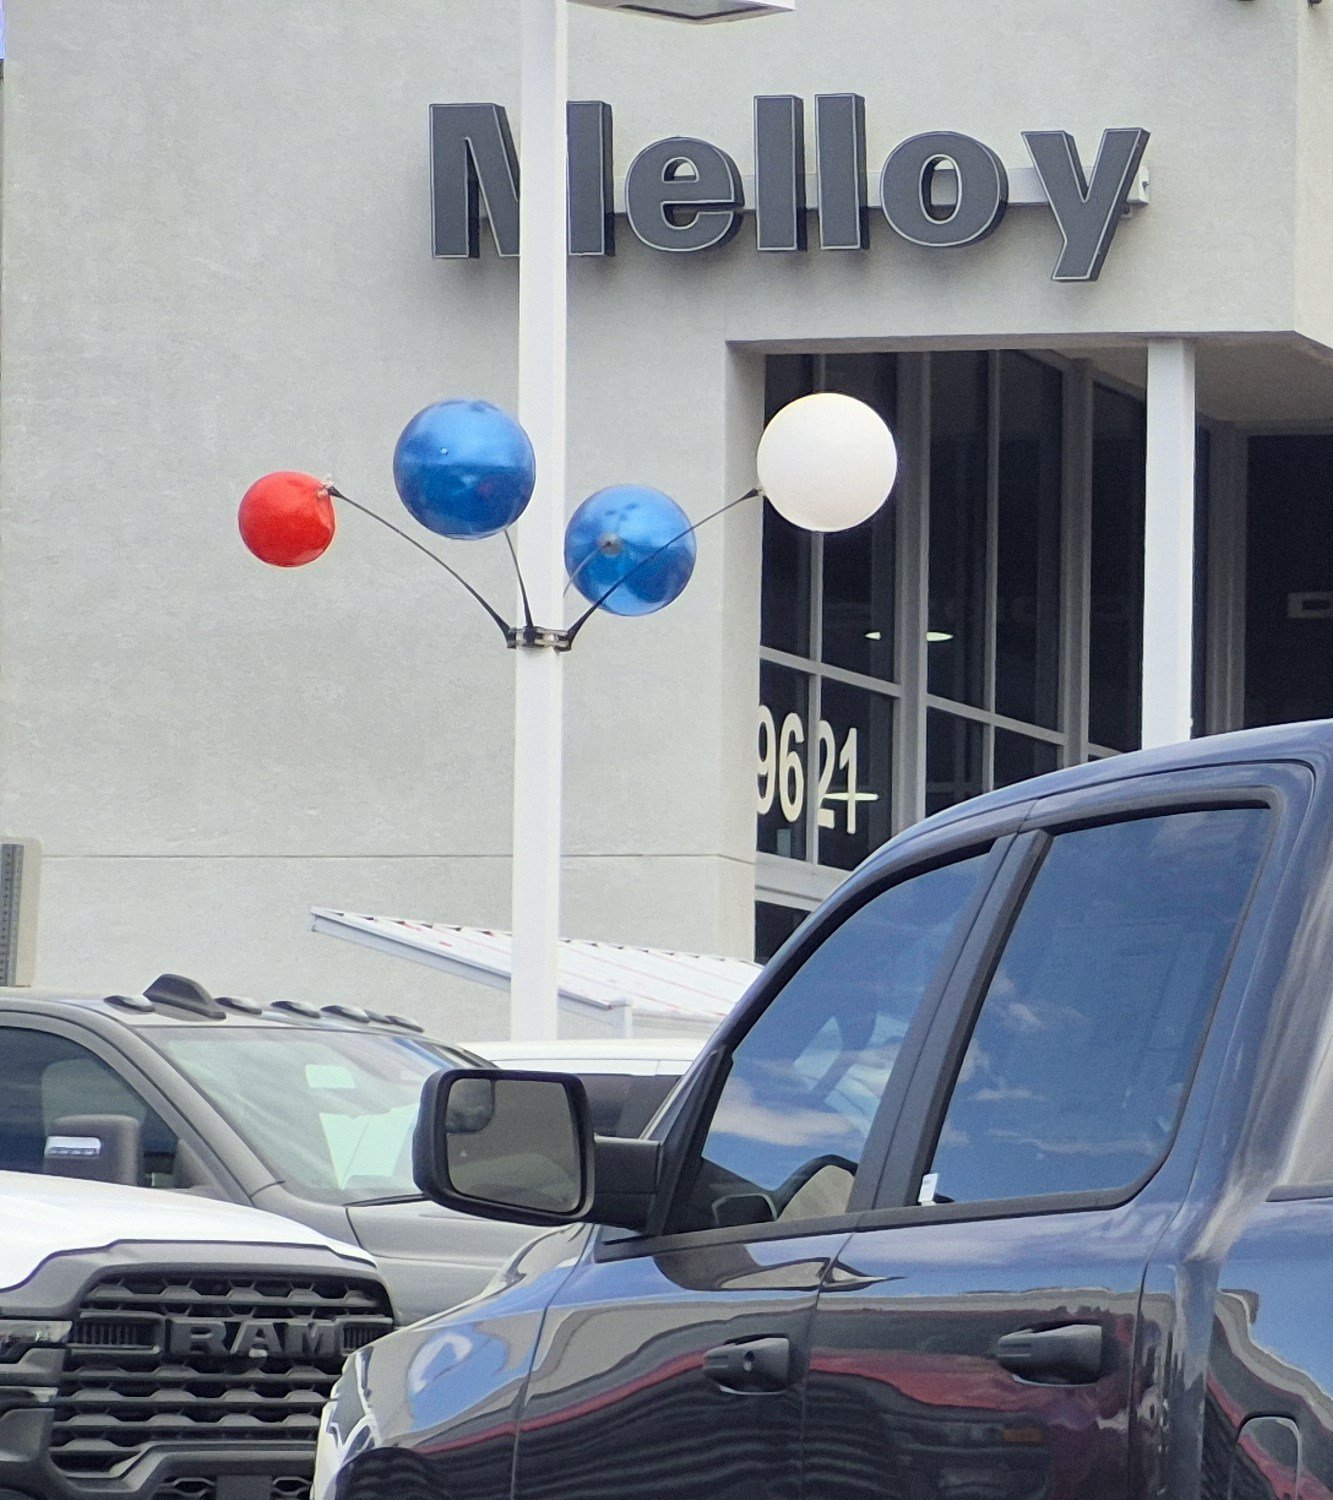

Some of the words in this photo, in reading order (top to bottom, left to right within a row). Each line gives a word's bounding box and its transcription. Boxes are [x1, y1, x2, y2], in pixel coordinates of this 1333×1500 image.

[429, 93, 1148, 281] Melloy
[756, 705, 858, 835] 9621
[165, 1316, 343, 1357] RAM
